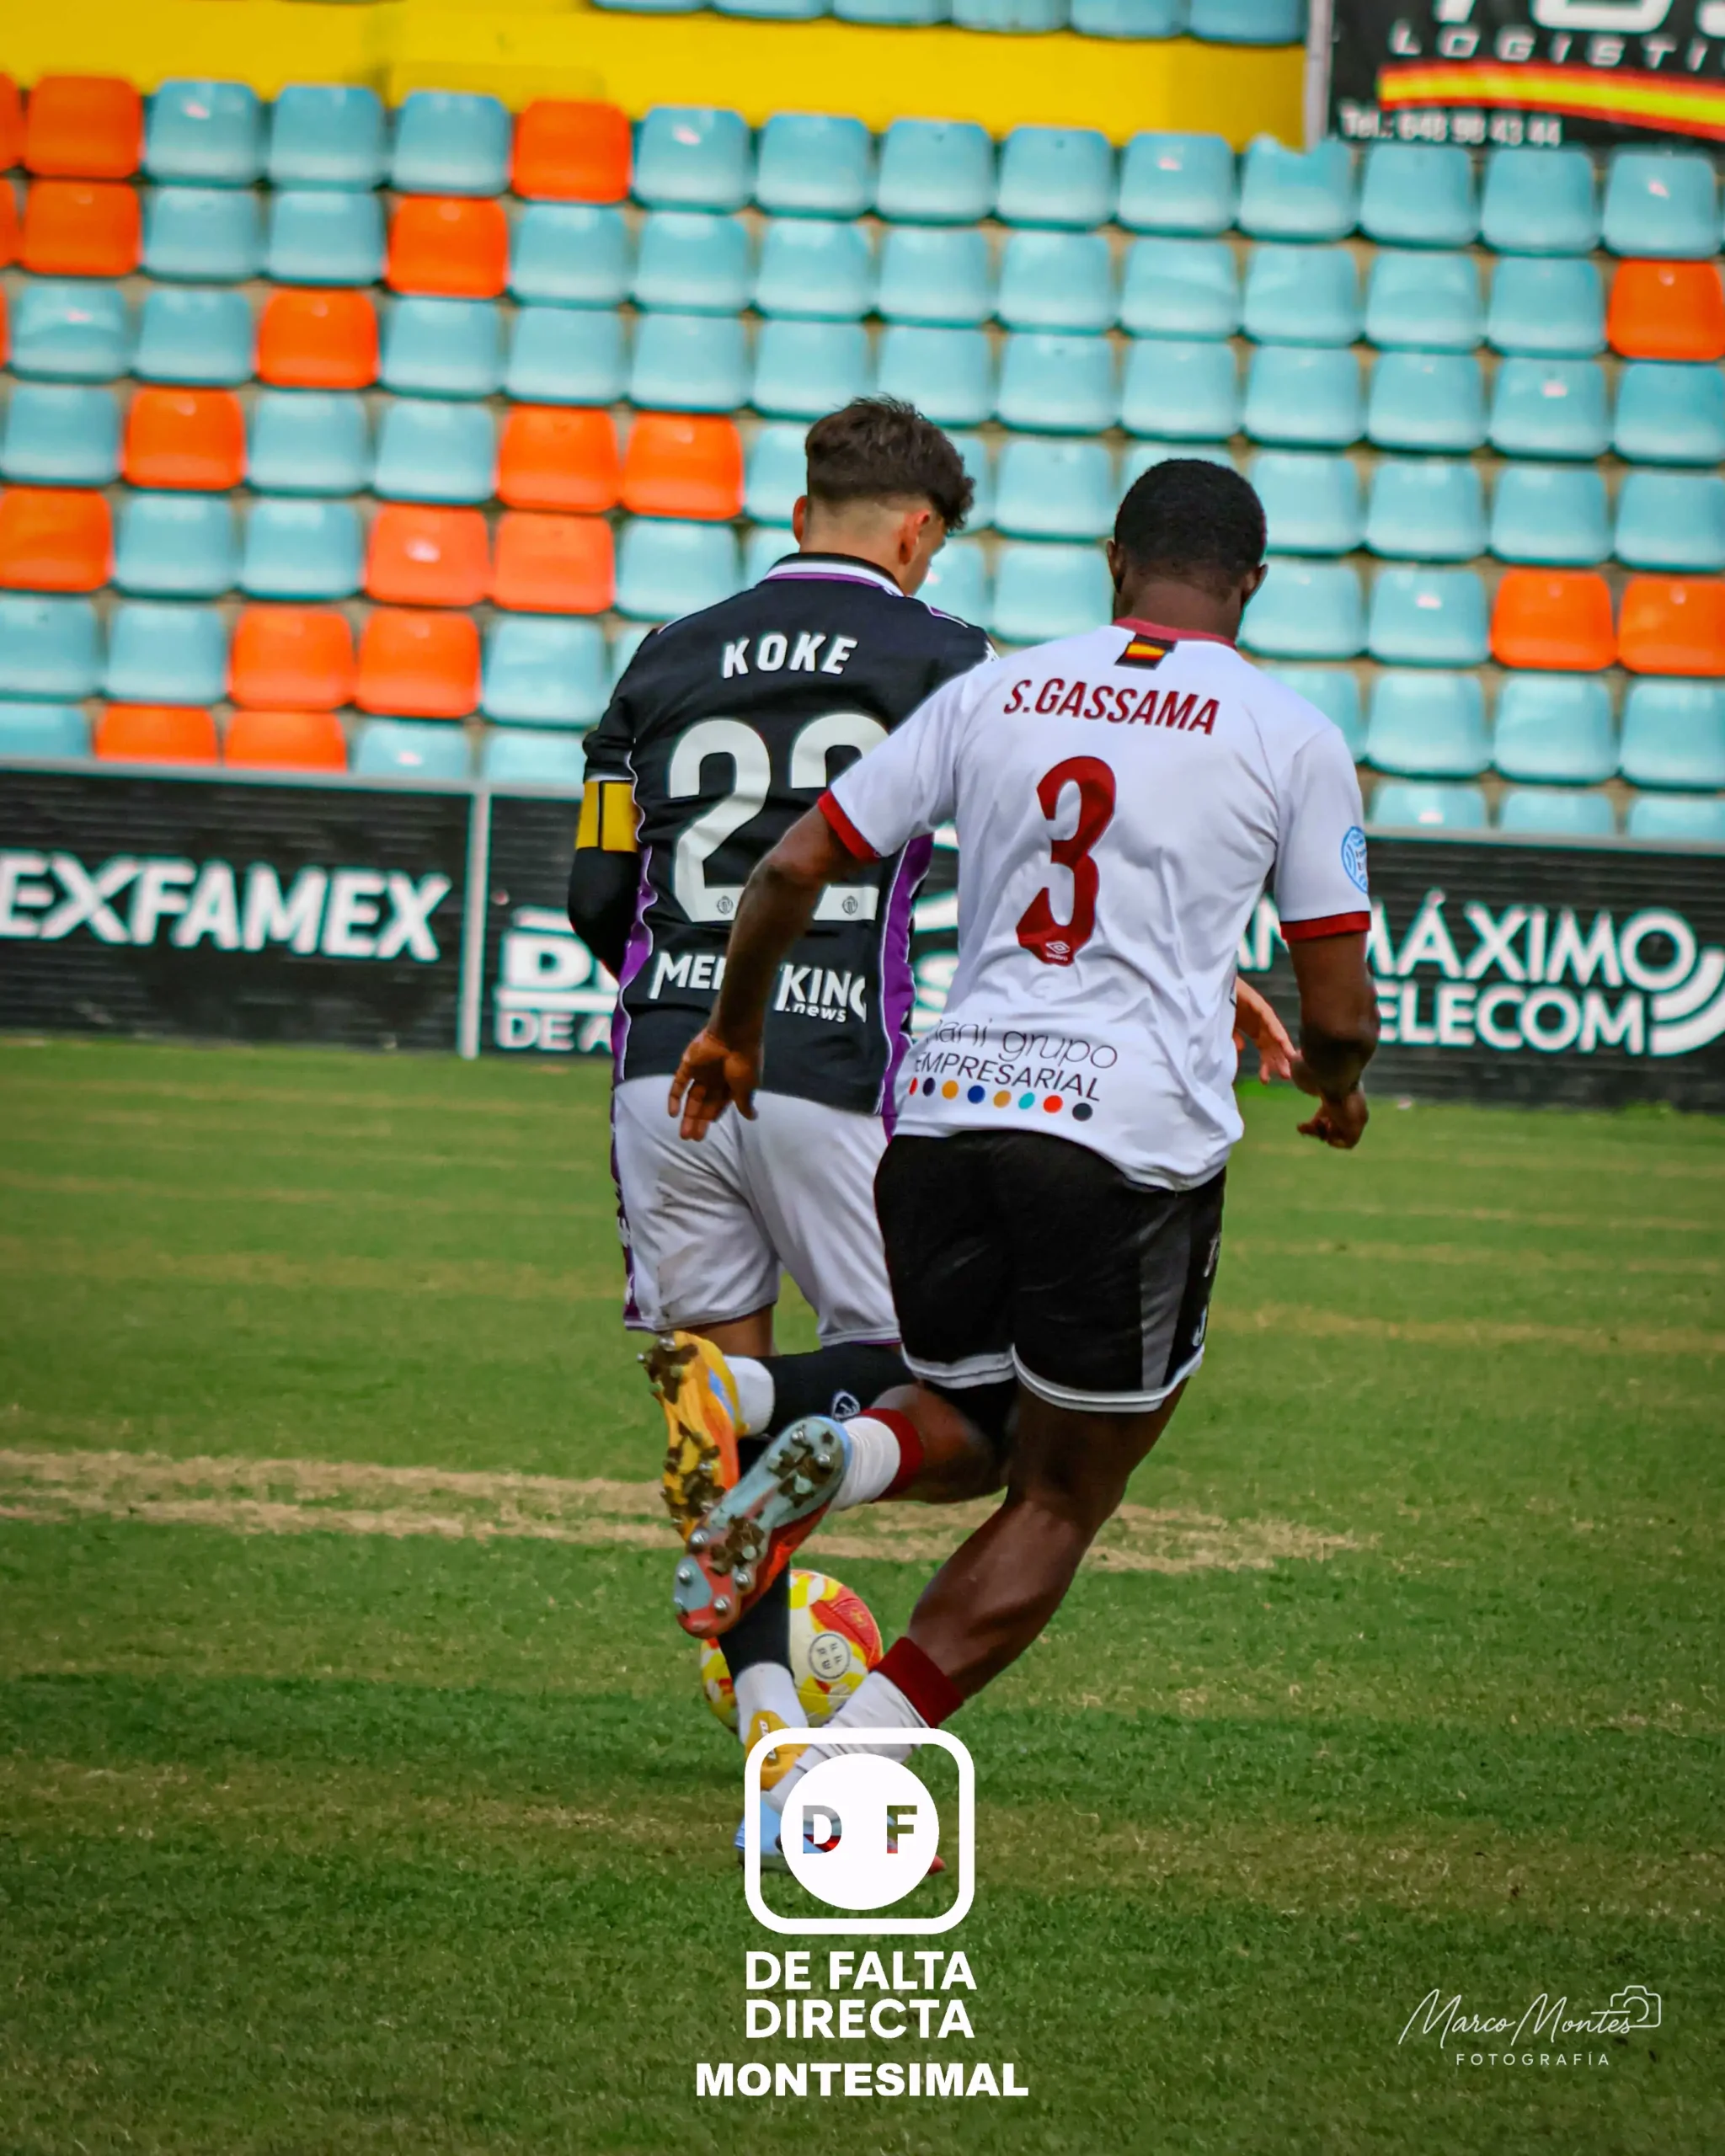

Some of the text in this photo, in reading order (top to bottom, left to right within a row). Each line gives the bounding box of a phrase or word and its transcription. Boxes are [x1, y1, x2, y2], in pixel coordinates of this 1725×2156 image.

[1390, 19, 1725, 72] LOGISTI
[722, 631, 858, 679] KOKE
[1003, 677, 1220, 735] S.GASSAMA
[668, 713, 891, 923] 22
[1016, 755, 1116, 966] 3
[0, 848, 451, 963] EXFAMEX
[498, 1011, 574, 1051] DE
[998, 1030, 1118, 1068] grupo
